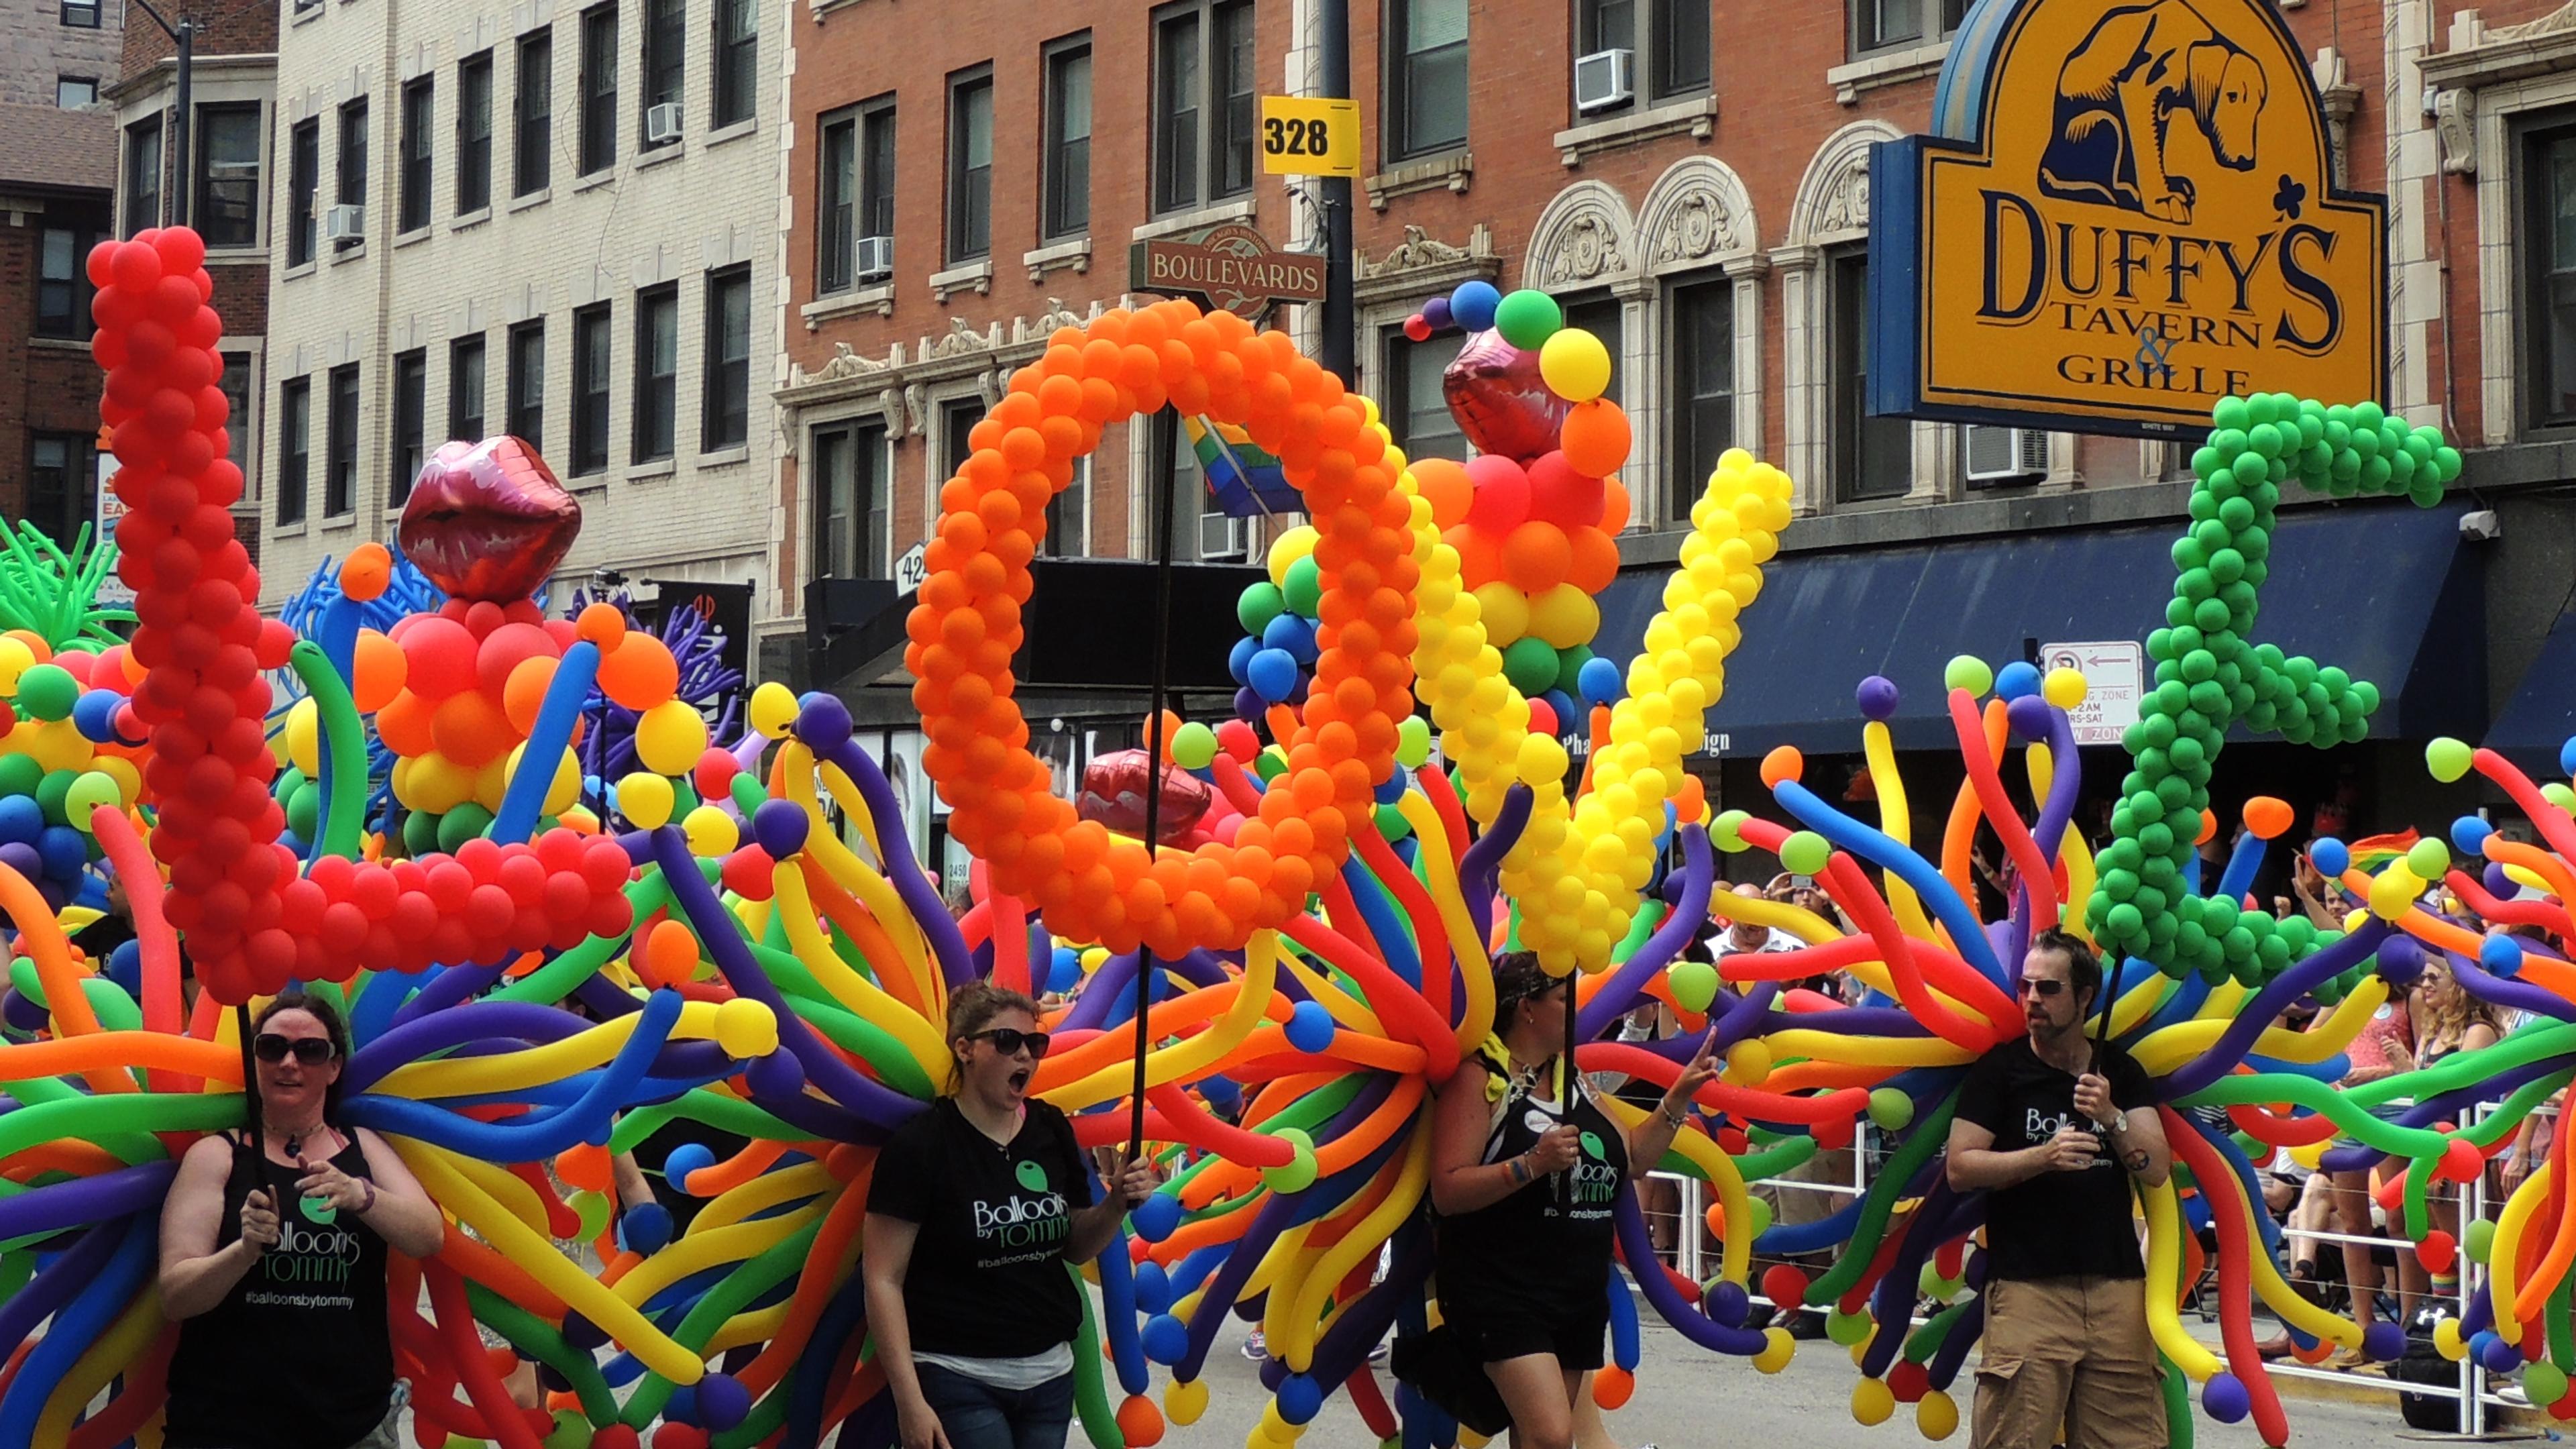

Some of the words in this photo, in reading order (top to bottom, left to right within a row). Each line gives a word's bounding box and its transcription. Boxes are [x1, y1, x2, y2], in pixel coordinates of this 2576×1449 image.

[1265, 117, 1328, 156] 328
[1153, 253, 1318, 292] BOULEVARDS
[2049, 301, 2263, 350] TAVERN
[2135, 326, 2178, 378] &
[2057, 354, 2253, 396] GRILLE
[902, 555, 923, 586] 42
[2102, 690, 2129, 700] ZONE
[2070, 713, 2103, 723] RS-SAT
[1562, 734, 1591, 755] Pha
[1699, 728, 1730, 757] ign
[2092, 727, 2123, 741] ZON
[273, 1221, 361, 1266] alloons
[977, 1225, 994, 1239] by
[246, 1291, 355, 1310] #balloonsbytommy
